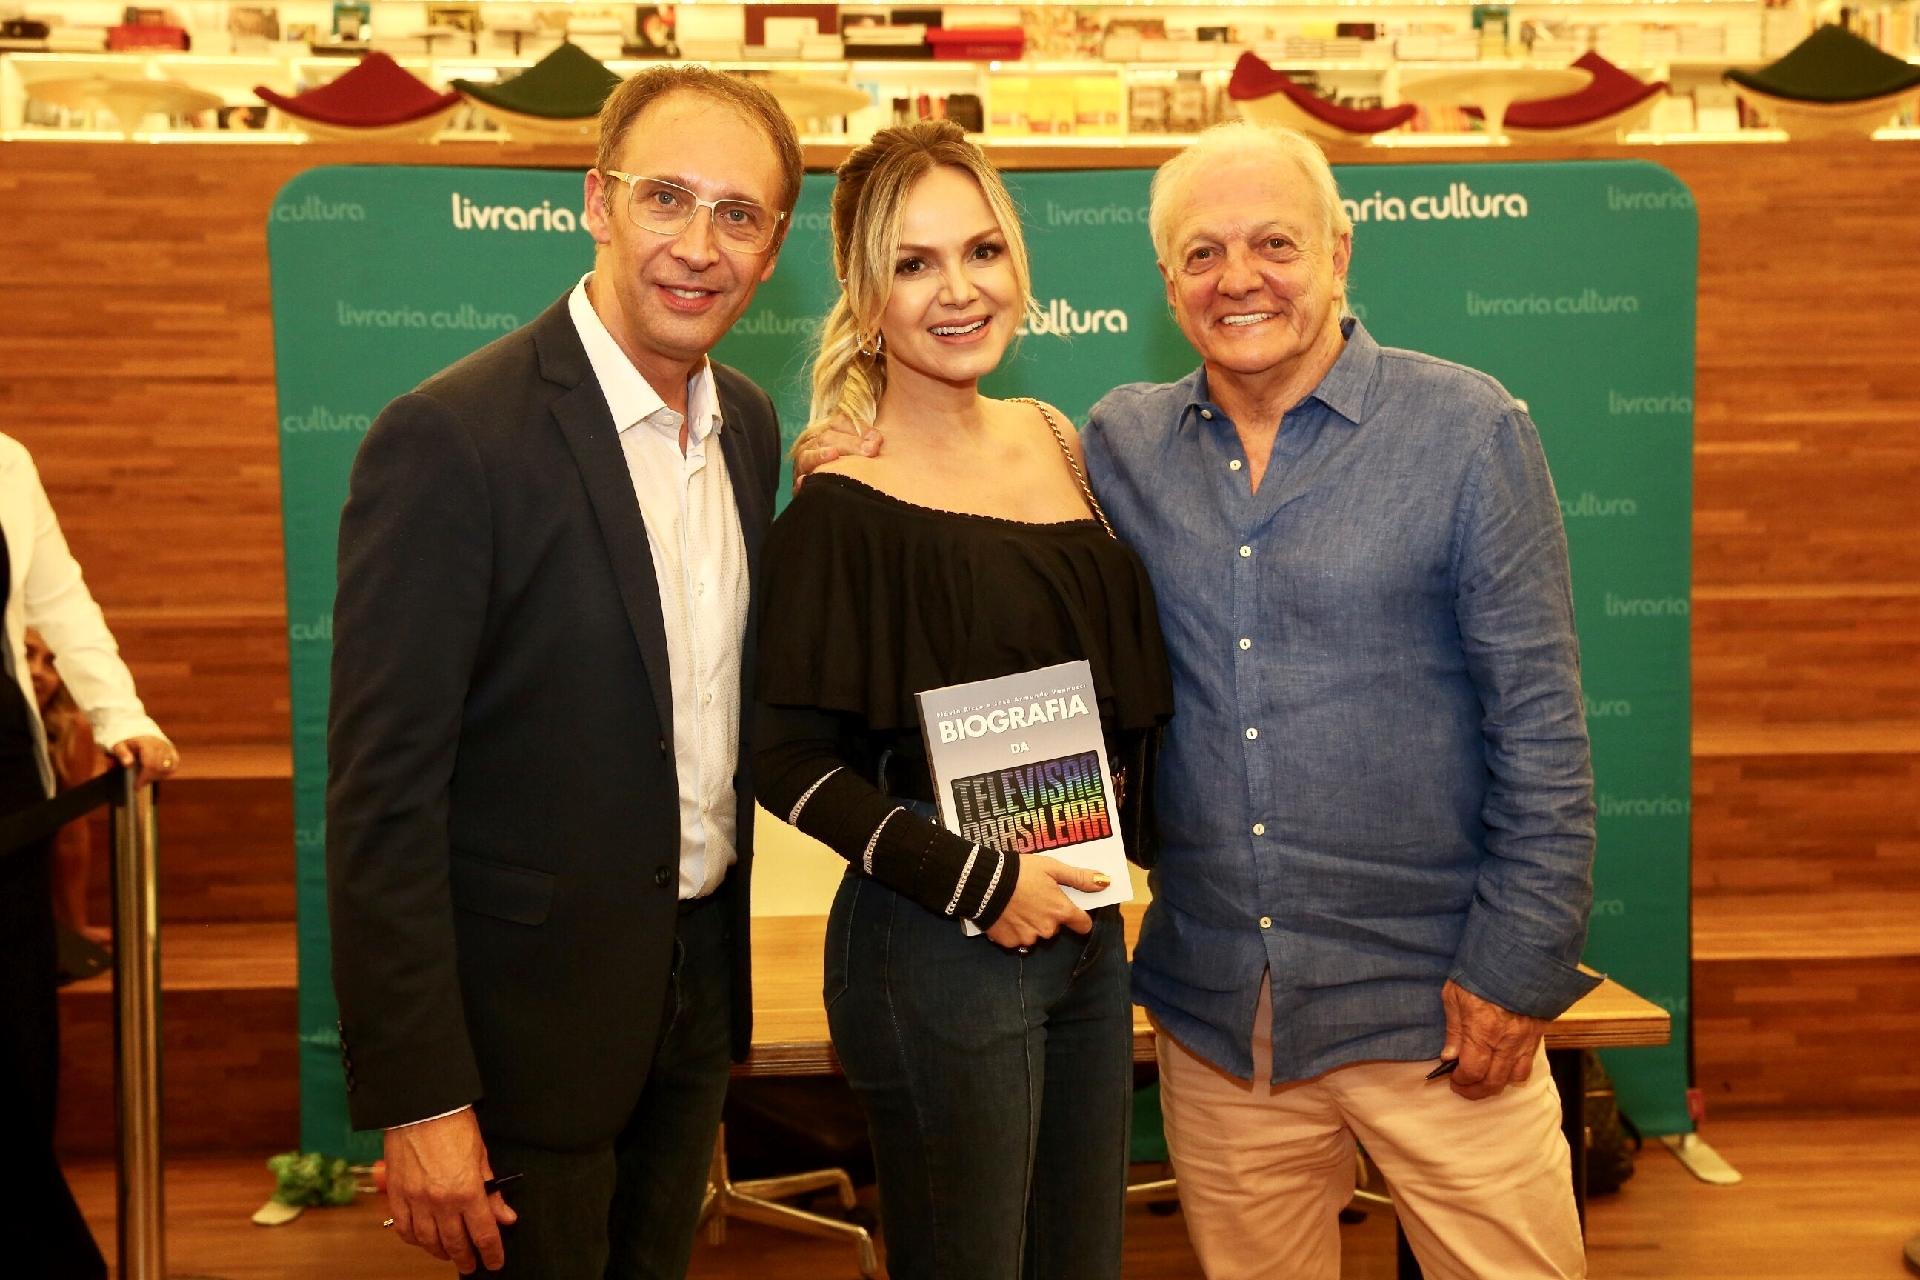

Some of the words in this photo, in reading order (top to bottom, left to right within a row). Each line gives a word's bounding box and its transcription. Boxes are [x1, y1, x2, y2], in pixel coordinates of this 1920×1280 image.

[276, 194, 366, 222] cultura
[1342, 190, 1406, 222] aria
[1410, 182, 1528, 221] cultura
[1607, 184, 1692, 211] livraria
[452, 192, 576, 232] livraria
[1047, 202, 1135, 225] livraria
[337, 300, 427, 328] livraria
[430, 303, 519, 330] cultura
[1466, 290, 1551, 316] livraria
[1554, 288, 1639, 313] cultura
[1609, 390, 1692, 414] livraria
[283, 406, 371, 432] cultura
[1605, 592, 1689, 617] livraria
[938, 694, 1090, 744] BIOGRAFIA
[1010, 741, 1030, 754] DA
[1600, 794, 1682, 817] livraria
